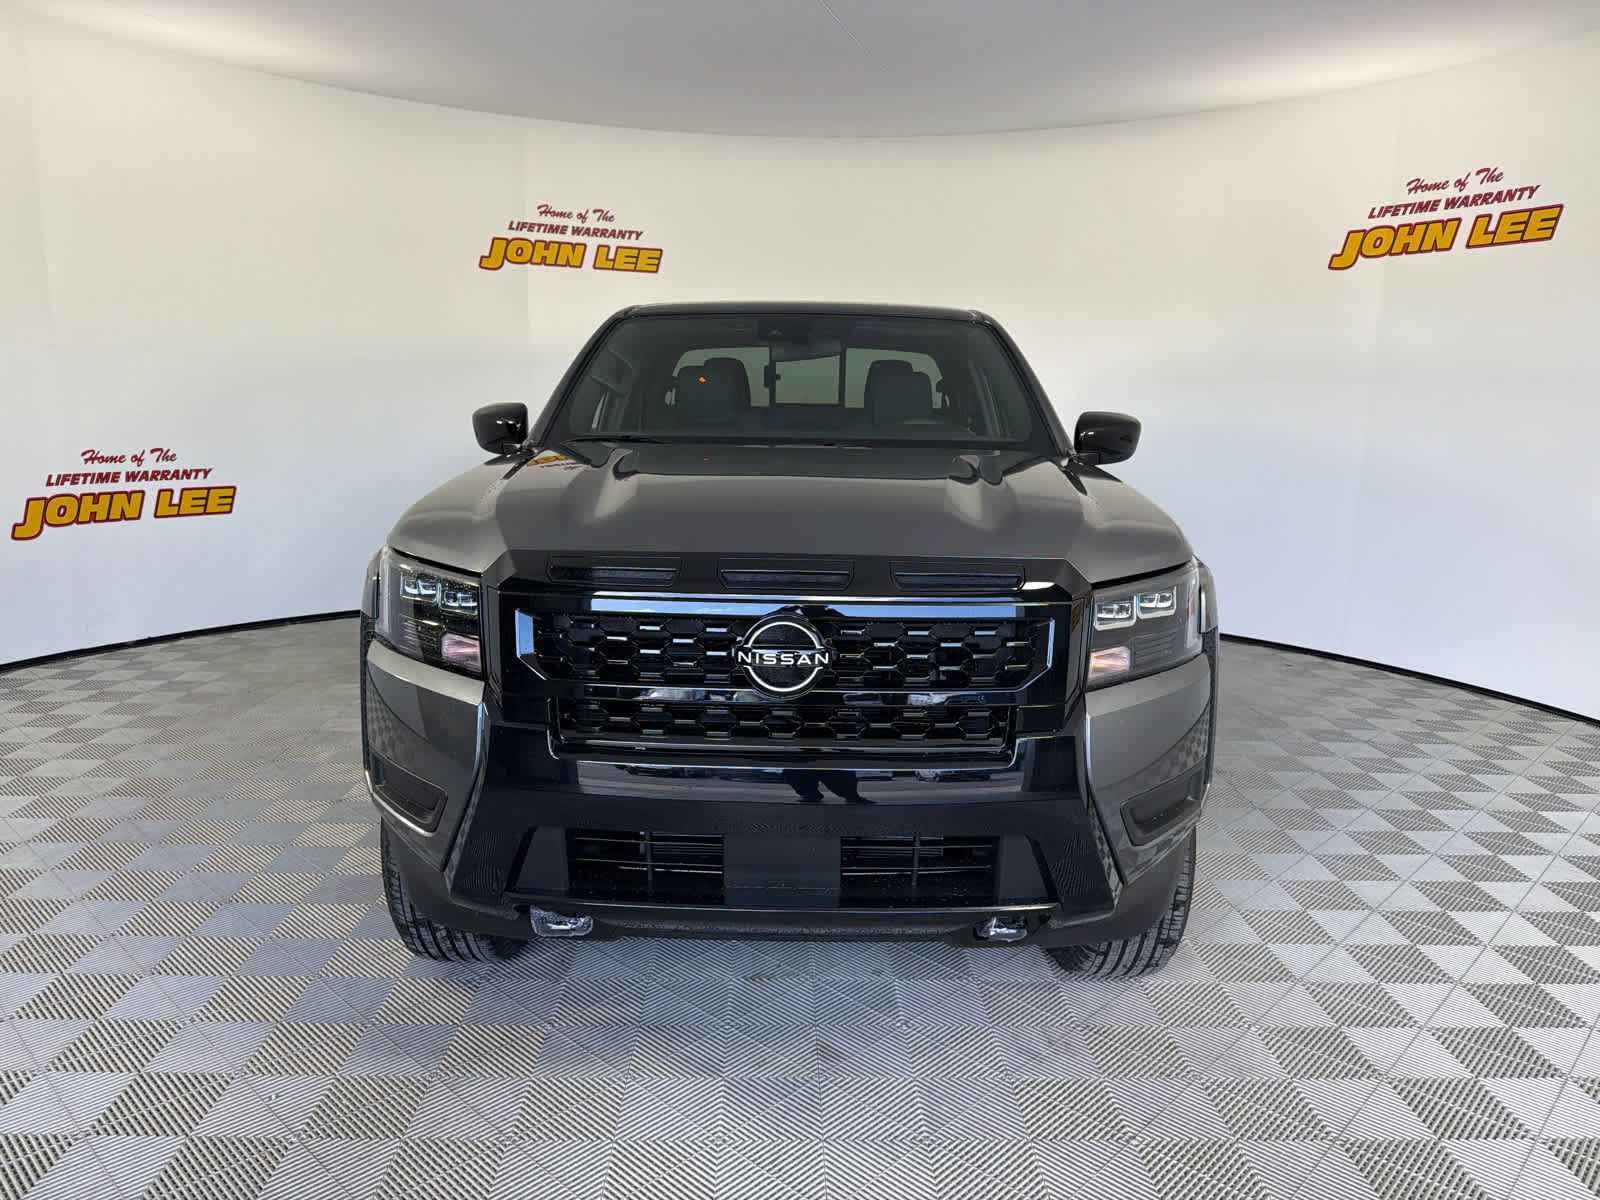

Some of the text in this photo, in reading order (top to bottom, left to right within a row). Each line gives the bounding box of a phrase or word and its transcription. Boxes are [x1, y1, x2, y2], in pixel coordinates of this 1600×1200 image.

[1406, 167, 1504, 195] Home of The
[537, 204, 615, 224] Home of The
[1368, 185, 1541, 219] LIFETIME WARRANTY
[508, 220, 644, 241] LIFETIME WARRANTY
[1328, 204, 1564, 271] JOHN LEE
[479, 237, 663, 274] JOHN LEE
[81, 448, 177, 467] Home of The
[46, 468, 213, 487] LIFETIME WARRANTY
[11, 486, 237, 541] JOHN LEE
[738, 651, 829, 665] NISSAN
